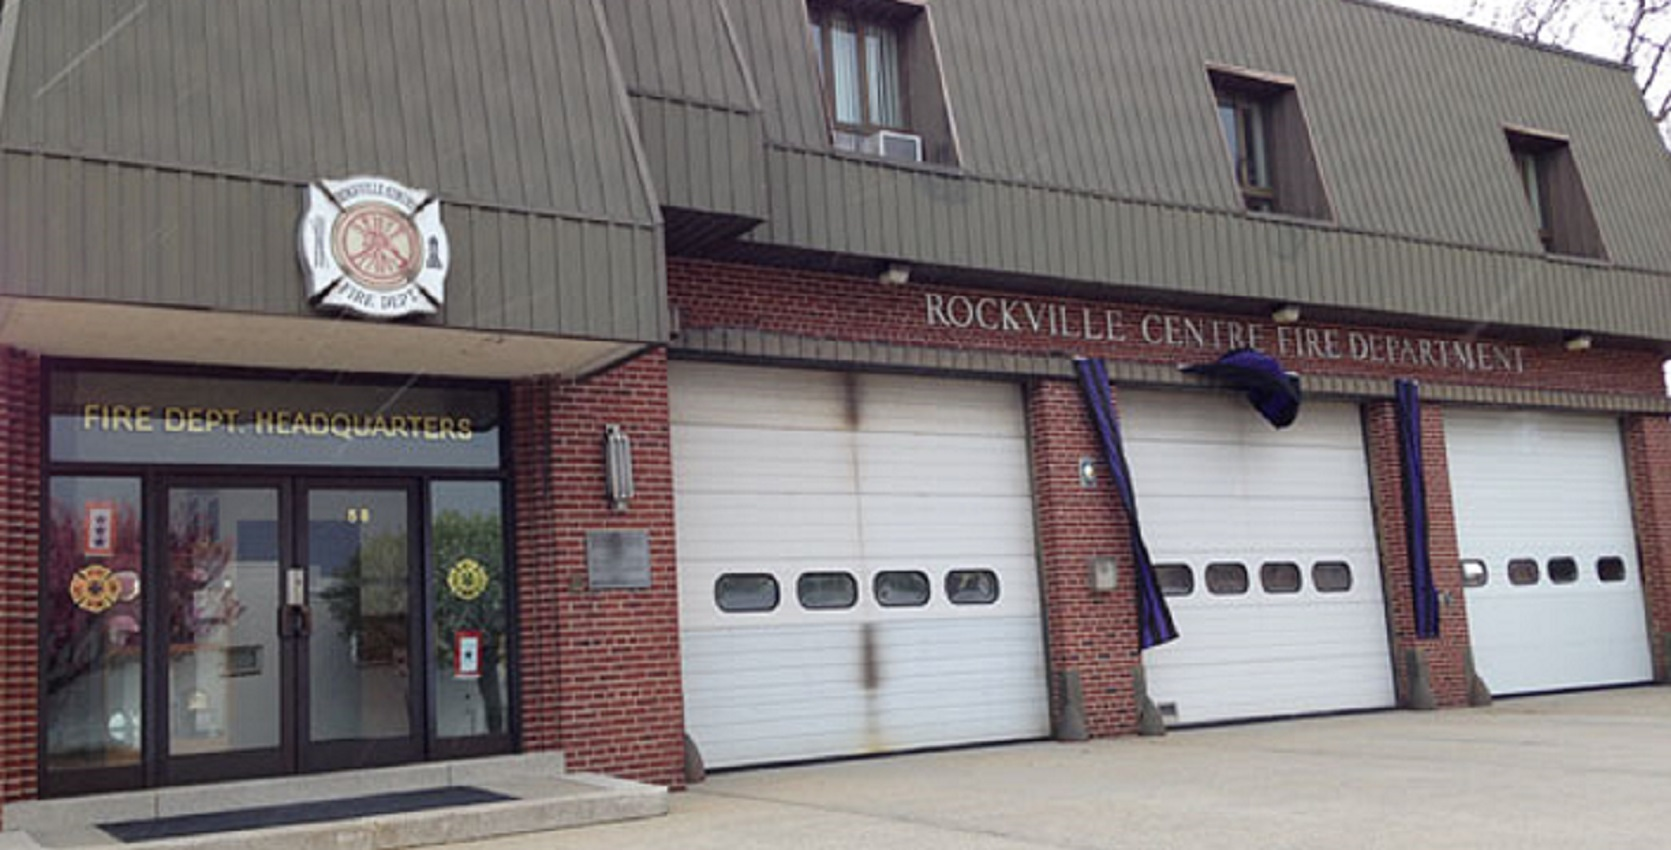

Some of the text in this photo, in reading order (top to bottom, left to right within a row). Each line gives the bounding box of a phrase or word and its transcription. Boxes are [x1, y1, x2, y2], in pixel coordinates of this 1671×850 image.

[338, 282, 375, 308] FIRE
[924, 293, 1525, 374] ROCKVILLE CENTRE FIRE DEPARTMENT
[84, 404, 473, 441] FIRE DEPT. HEADQUARTERS
